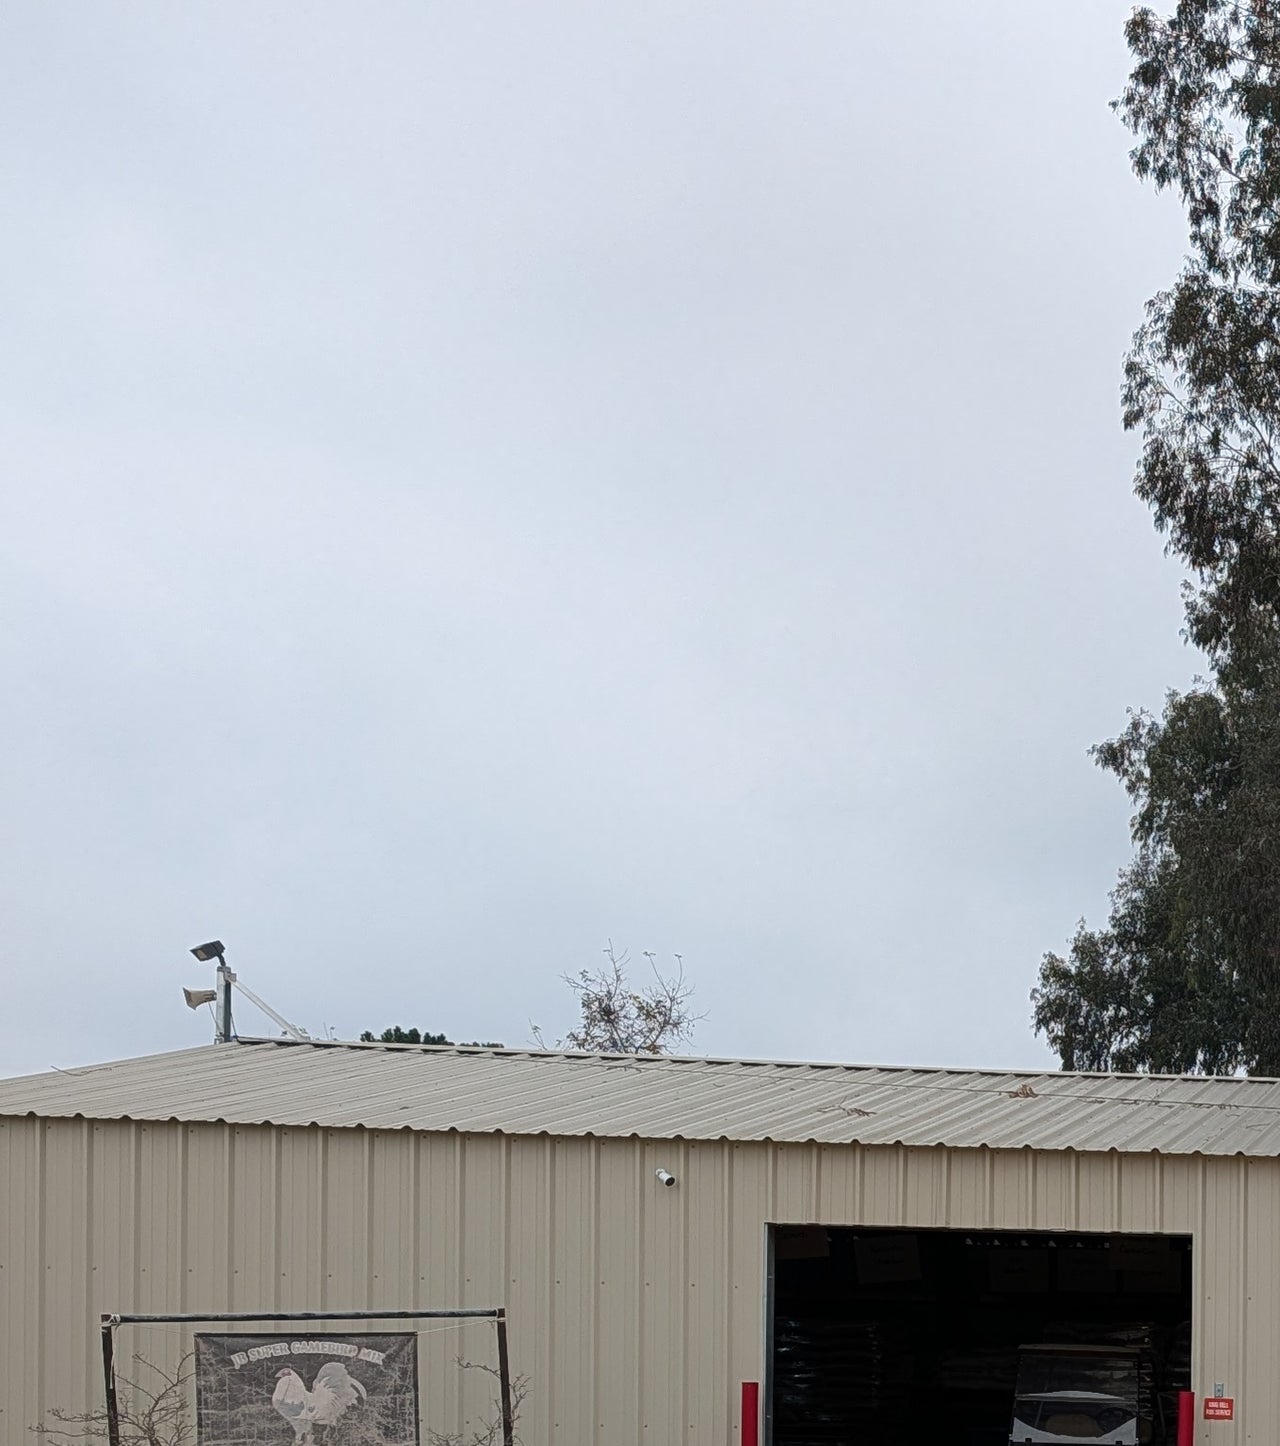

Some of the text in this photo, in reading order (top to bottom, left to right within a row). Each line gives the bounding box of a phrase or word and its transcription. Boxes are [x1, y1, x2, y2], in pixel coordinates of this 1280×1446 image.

[247, 1342, 291, 1362] SUPER
[290, 1340, 359, 1358] GAMEBIRD
[357, 1347, 386, 1366] MIX
